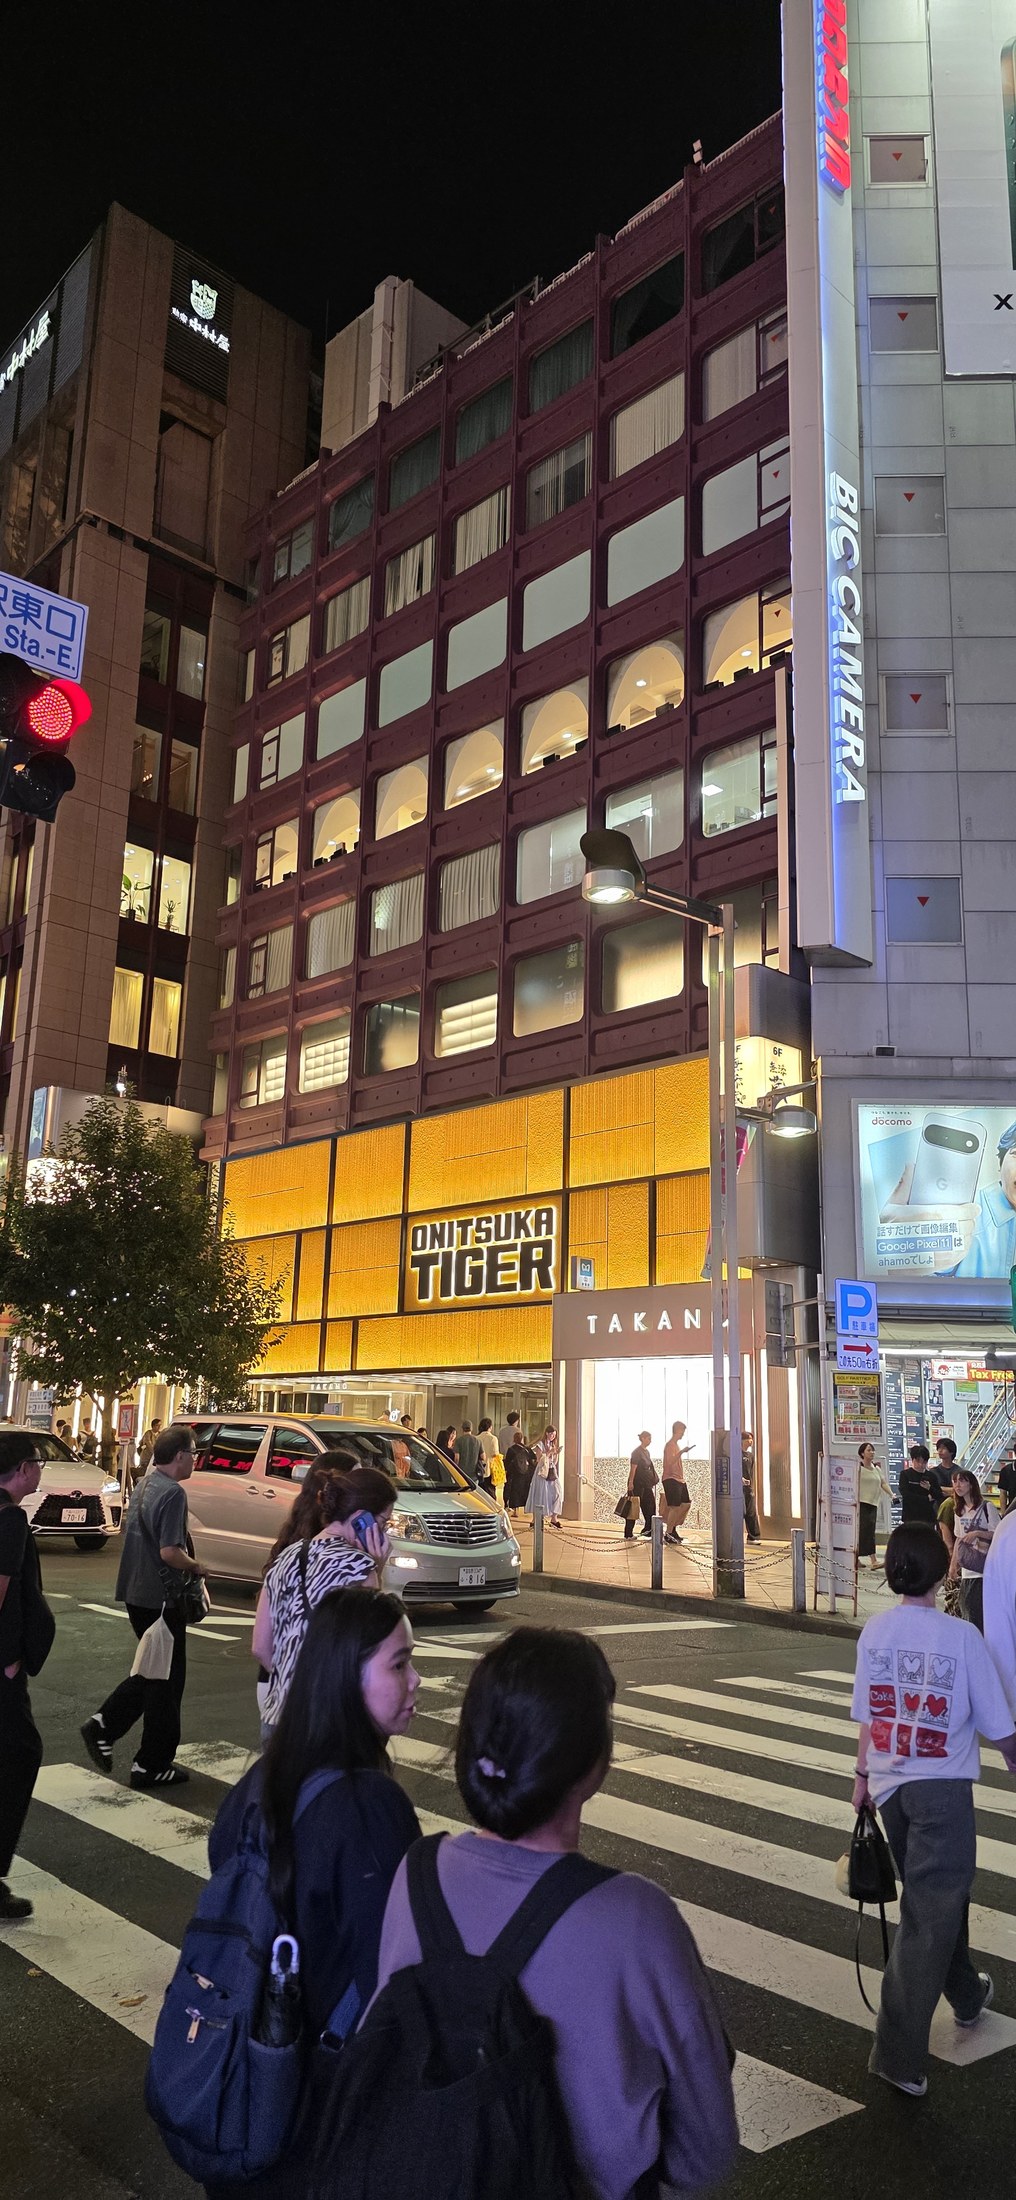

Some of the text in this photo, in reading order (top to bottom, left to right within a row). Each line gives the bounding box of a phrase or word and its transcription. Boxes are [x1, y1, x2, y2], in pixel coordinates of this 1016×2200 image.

[4, 624, 75, 671] Sta.-E.
[830, 471, 865, 804] BIC CAMERA
[773, 1046, 783, 1057] 6F
[872, 1117, 912, 1126] docomo
[410, 1206, 555, 1252] ONITSUKA
[877, 1222, 958, 1237] 話すだけで画像編集
[878, 1241, 915, 1253] Google
[410, 1238, 555, 1302] TIGER
[878, 1254, 934, 1267] ahamoでしょ
[840, 1284, 872, 1330] P
[586, 1308, 729, 1334] TAKAN
[970, 1369, 989, 1379] Tax
[991, 1370, 1015, 1381] Free
